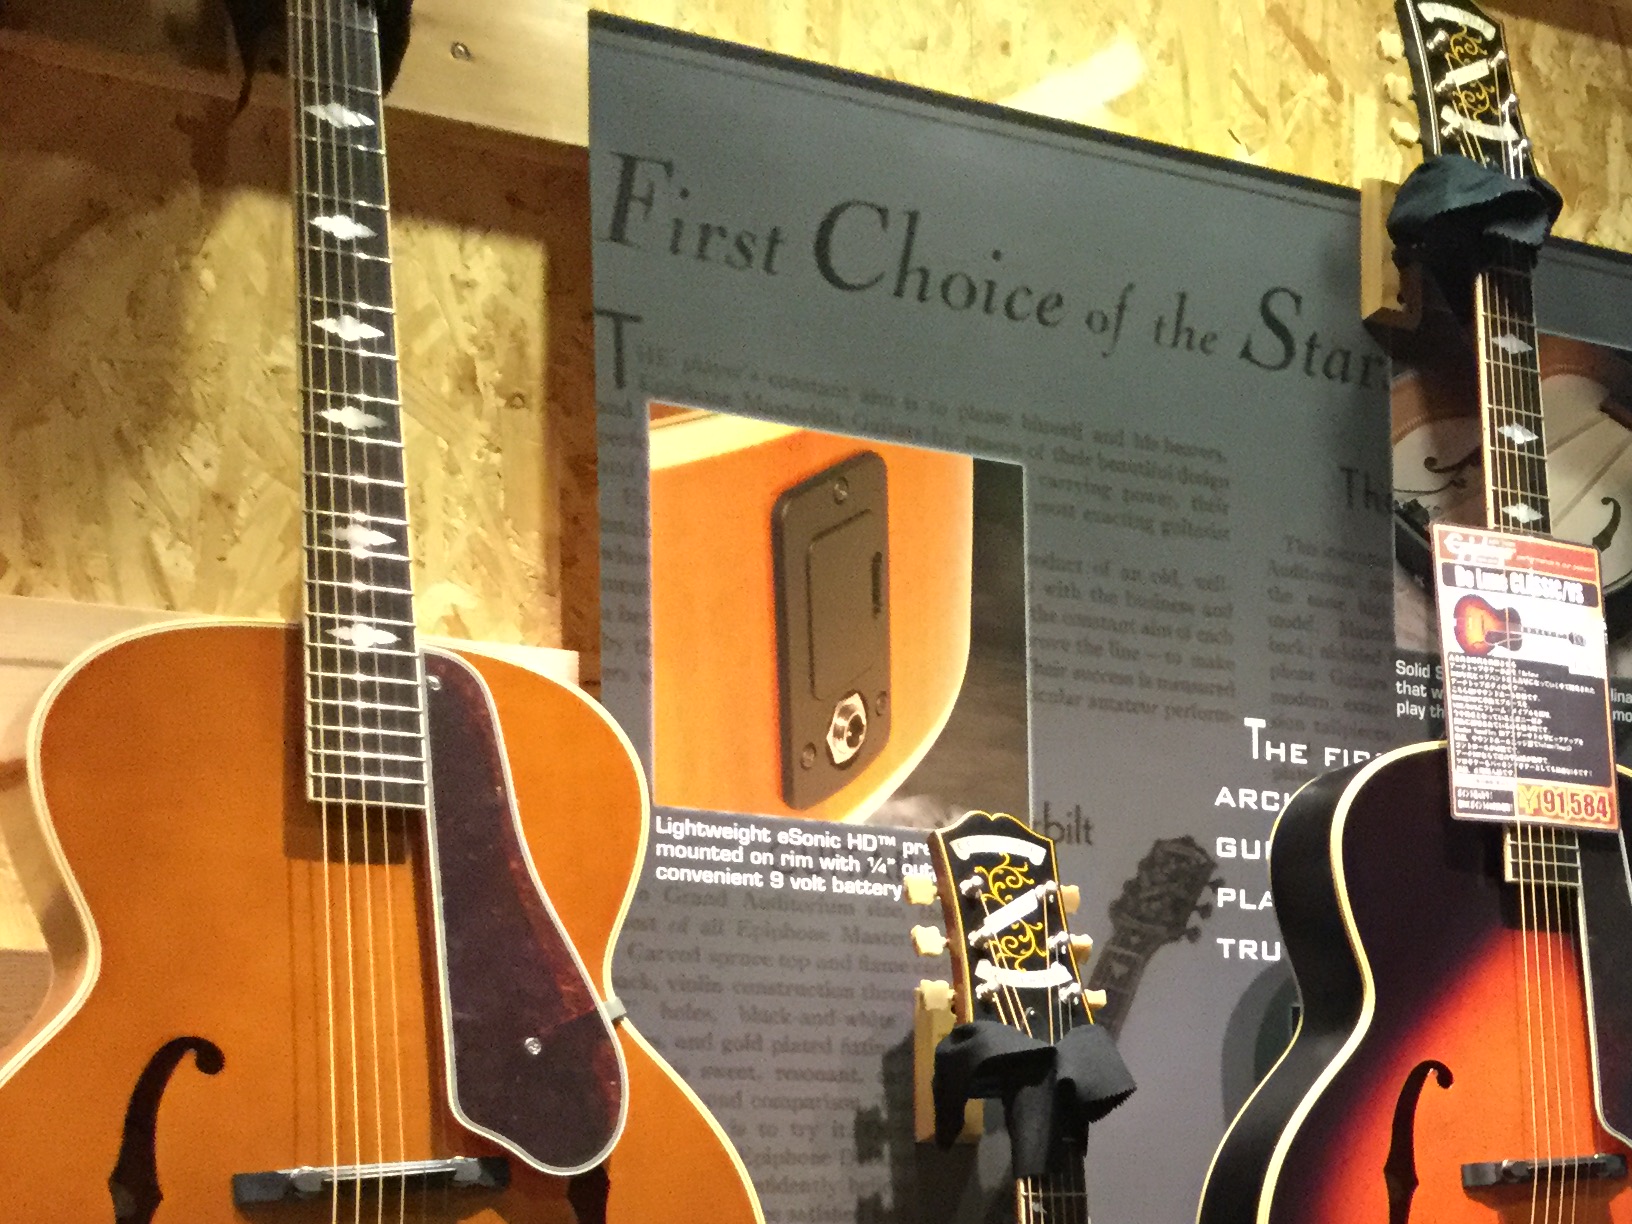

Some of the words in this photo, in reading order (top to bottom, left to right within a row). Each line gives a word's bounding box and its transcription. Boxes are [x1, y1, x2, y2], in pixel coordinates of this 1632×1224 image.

[600, 151, 787, 276] First
[811, 199, 1066, 328] Choice
[1086, 281, 1138, 357] of
[1152, 291, 1219, 356] the
[1395, 659, 1434, 681] Solid
[1395, 679, 1428, 700] that
[1395, 700, 1427, 721] play
[1323, 745, 1381, 768] FIR
[1518, 785, 1610, 821] ¥91,584
[655, 816, 772, 848] Lightweight
[776, 827, 842, 851] eSonic
[655, 841, 745, 865] mounted
[749, 849, 775, 866] on
[779, 850, 814, 869] rim
[819, 855, 861, 874] with
[655, 865, 765, 889] convenient
[768, 870, 786, 890] 9
[789, 874, 828, 894] volt
[831, 876, 903, 903] battery
